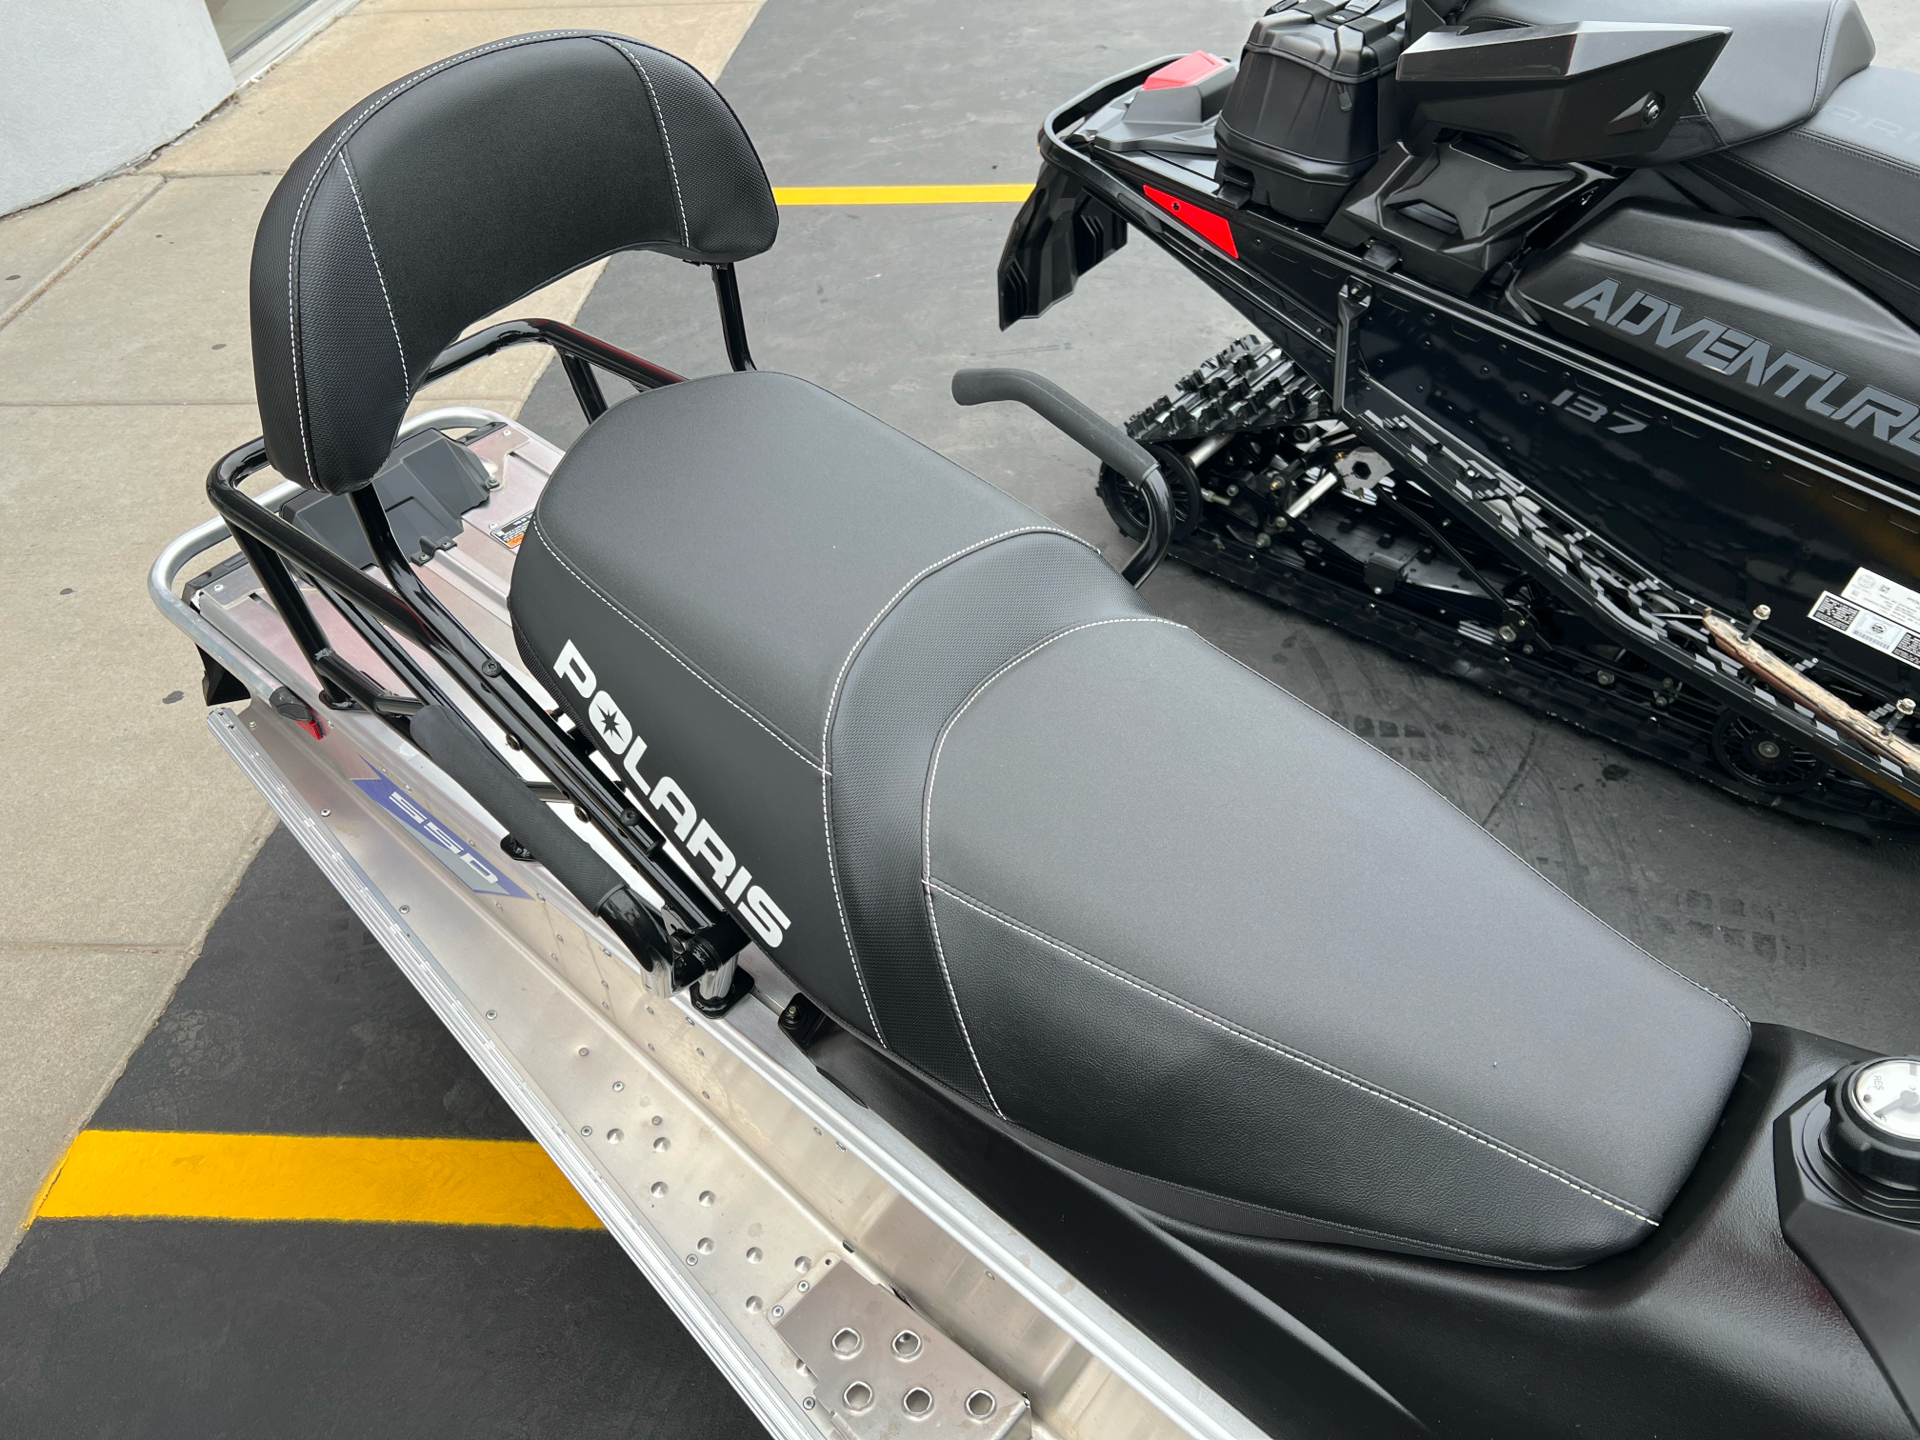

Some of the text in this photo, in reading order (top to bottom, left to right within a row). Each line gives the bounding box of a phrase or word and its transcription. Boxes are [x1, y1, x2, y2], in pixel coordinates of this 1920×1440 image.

[1551, 389, 1648, 434] 137
[553, 639, 792, 948] POLARIS
[1873, 1075, 1884, 1091] RES
